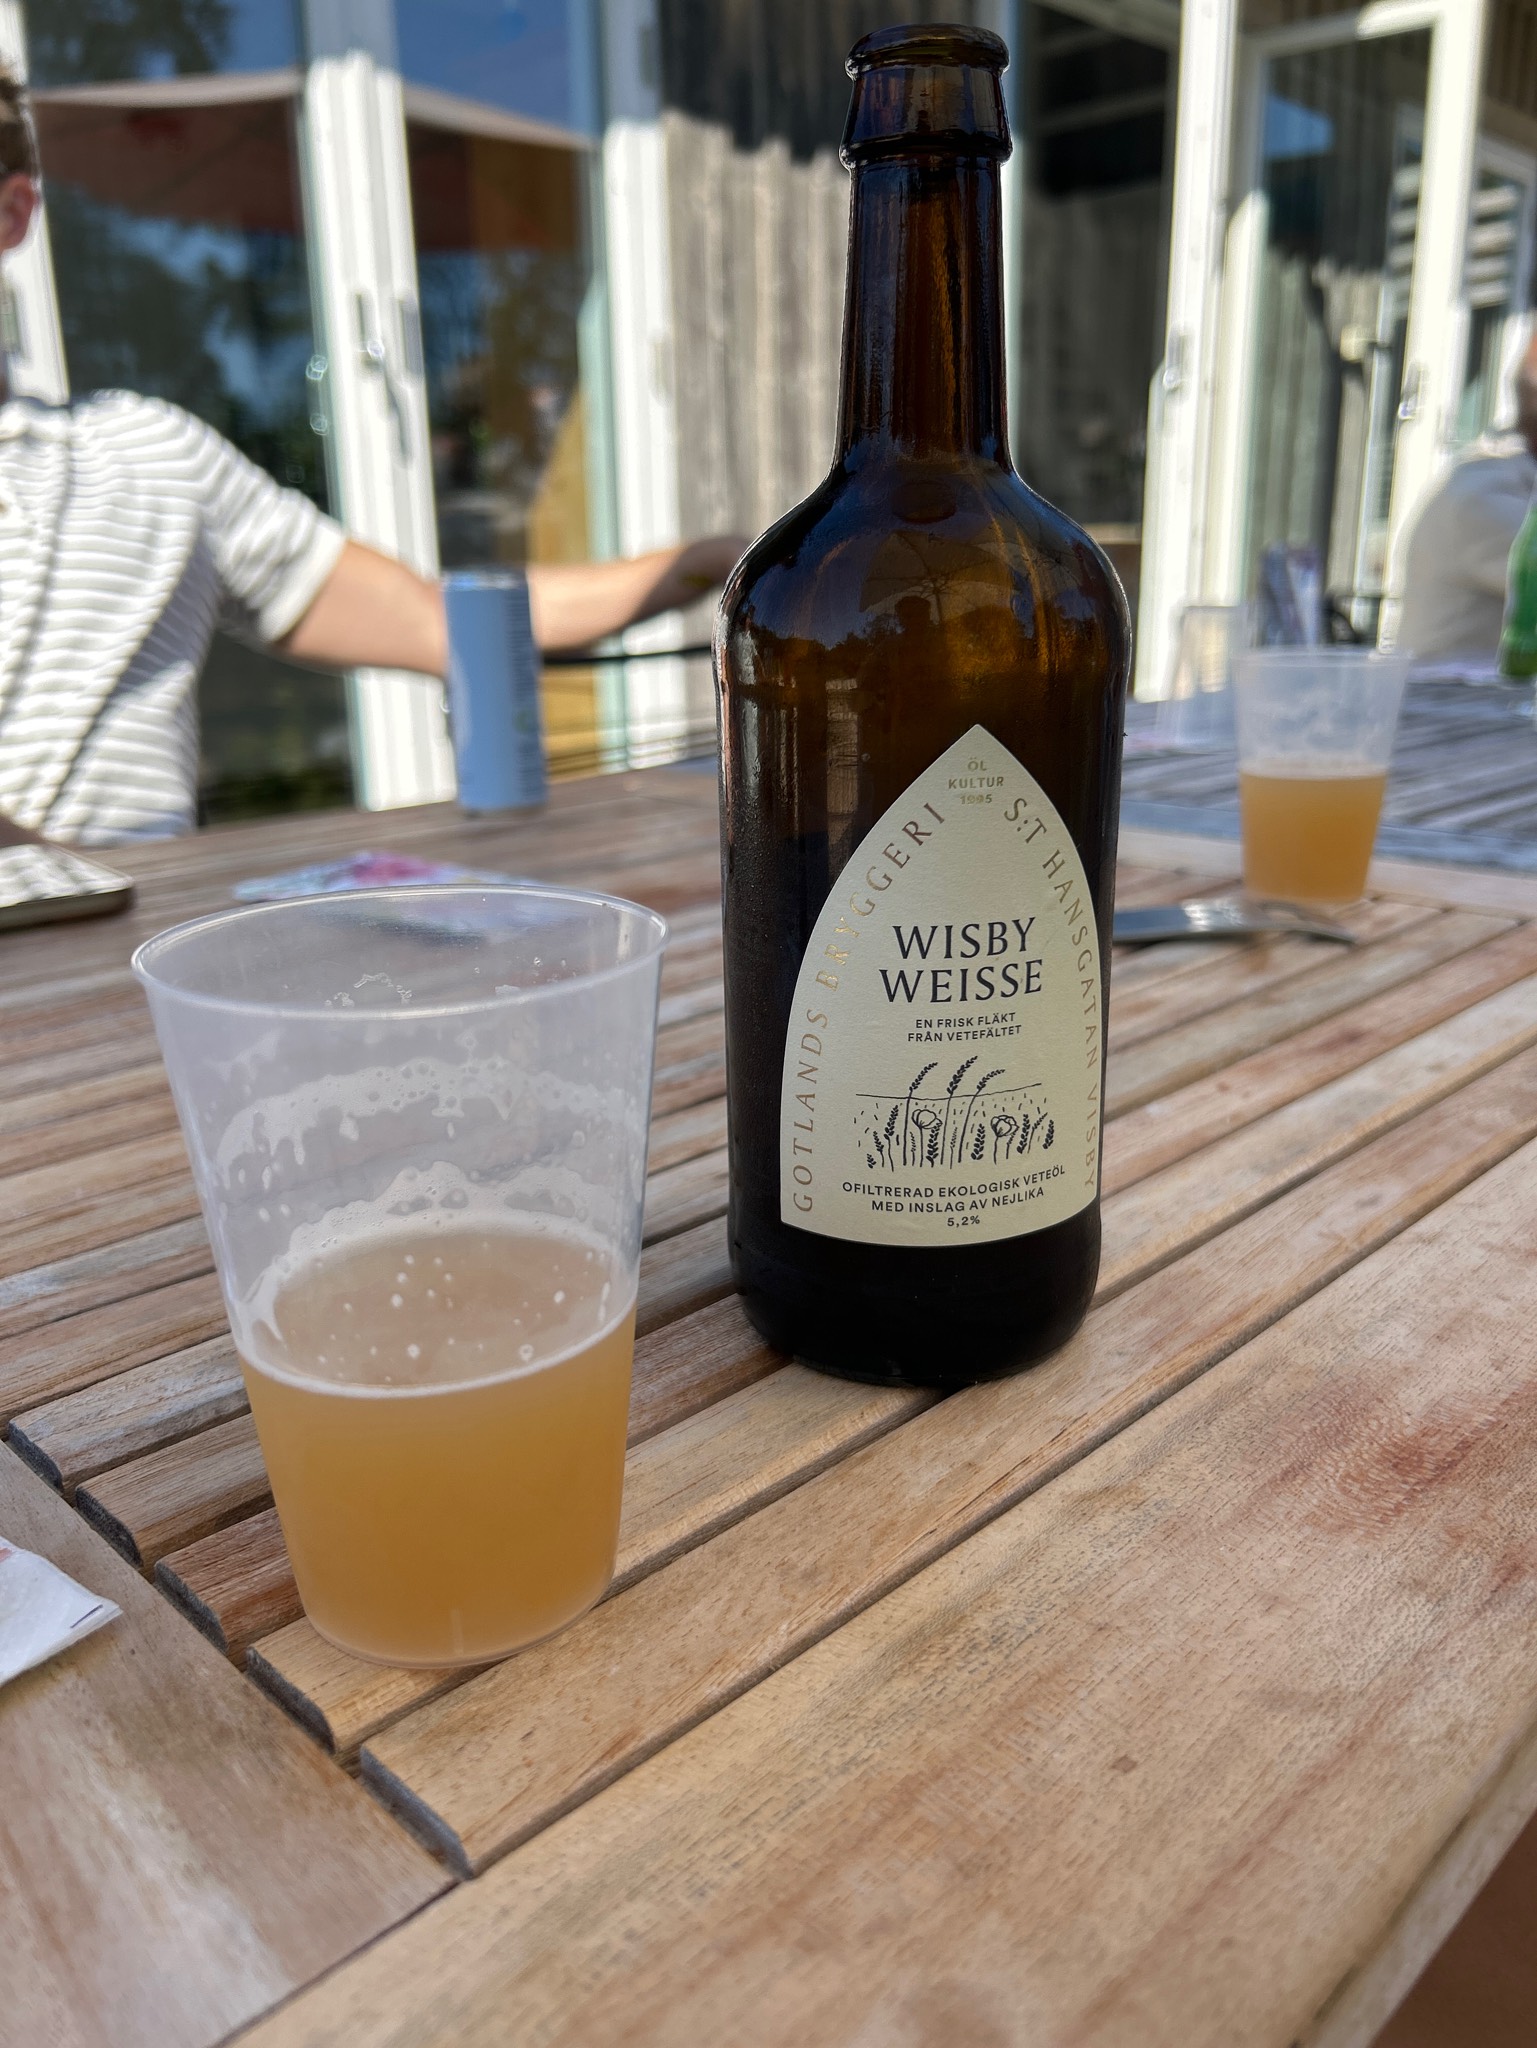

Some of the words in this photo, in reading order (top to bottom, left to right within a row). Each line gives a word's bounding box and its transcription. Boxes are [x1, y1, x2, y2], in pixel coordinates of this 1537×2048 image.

[967, 757, 987, 771] ÖL
[948, 776, 1004, 790] KULTUR
[892, 917, 1036, 960] WISBY
[879, 959, 1043, 1003] WEISSE
[792, 1009, 828, 1212] GOTLANDS
[815, 803, 945, 991] BRYGGERI
[916, 1019, 933, 1029] EN
[937, 1017, 974, 1029] FRISK
[978, 1012, 1016, 1026] FLÄKT
[1042, 850, 1097, 1069] HANSGATAN
[1084, 1084, 1097, 1188] VISBY
[908, 1030, 943, 1042] FRÅN
[947, 1025, 1022, 1041] VETEFÄLTET
[842, 1182, 933, 1198] OFILTRERAD
[939, 1177, 1019, 1198] EKOLOGISK
[1023, 1165, 1065, 1187] VETEÖL
[872, 1200, 904, 1212] MED
[909, 1201, 965, 1213] INSLAG
[969, 1198, 986, 1211] AV
[991, 1187, 1044, 1207] NEJLIKA
[947, 1215, 980, 1228] 5,2%
